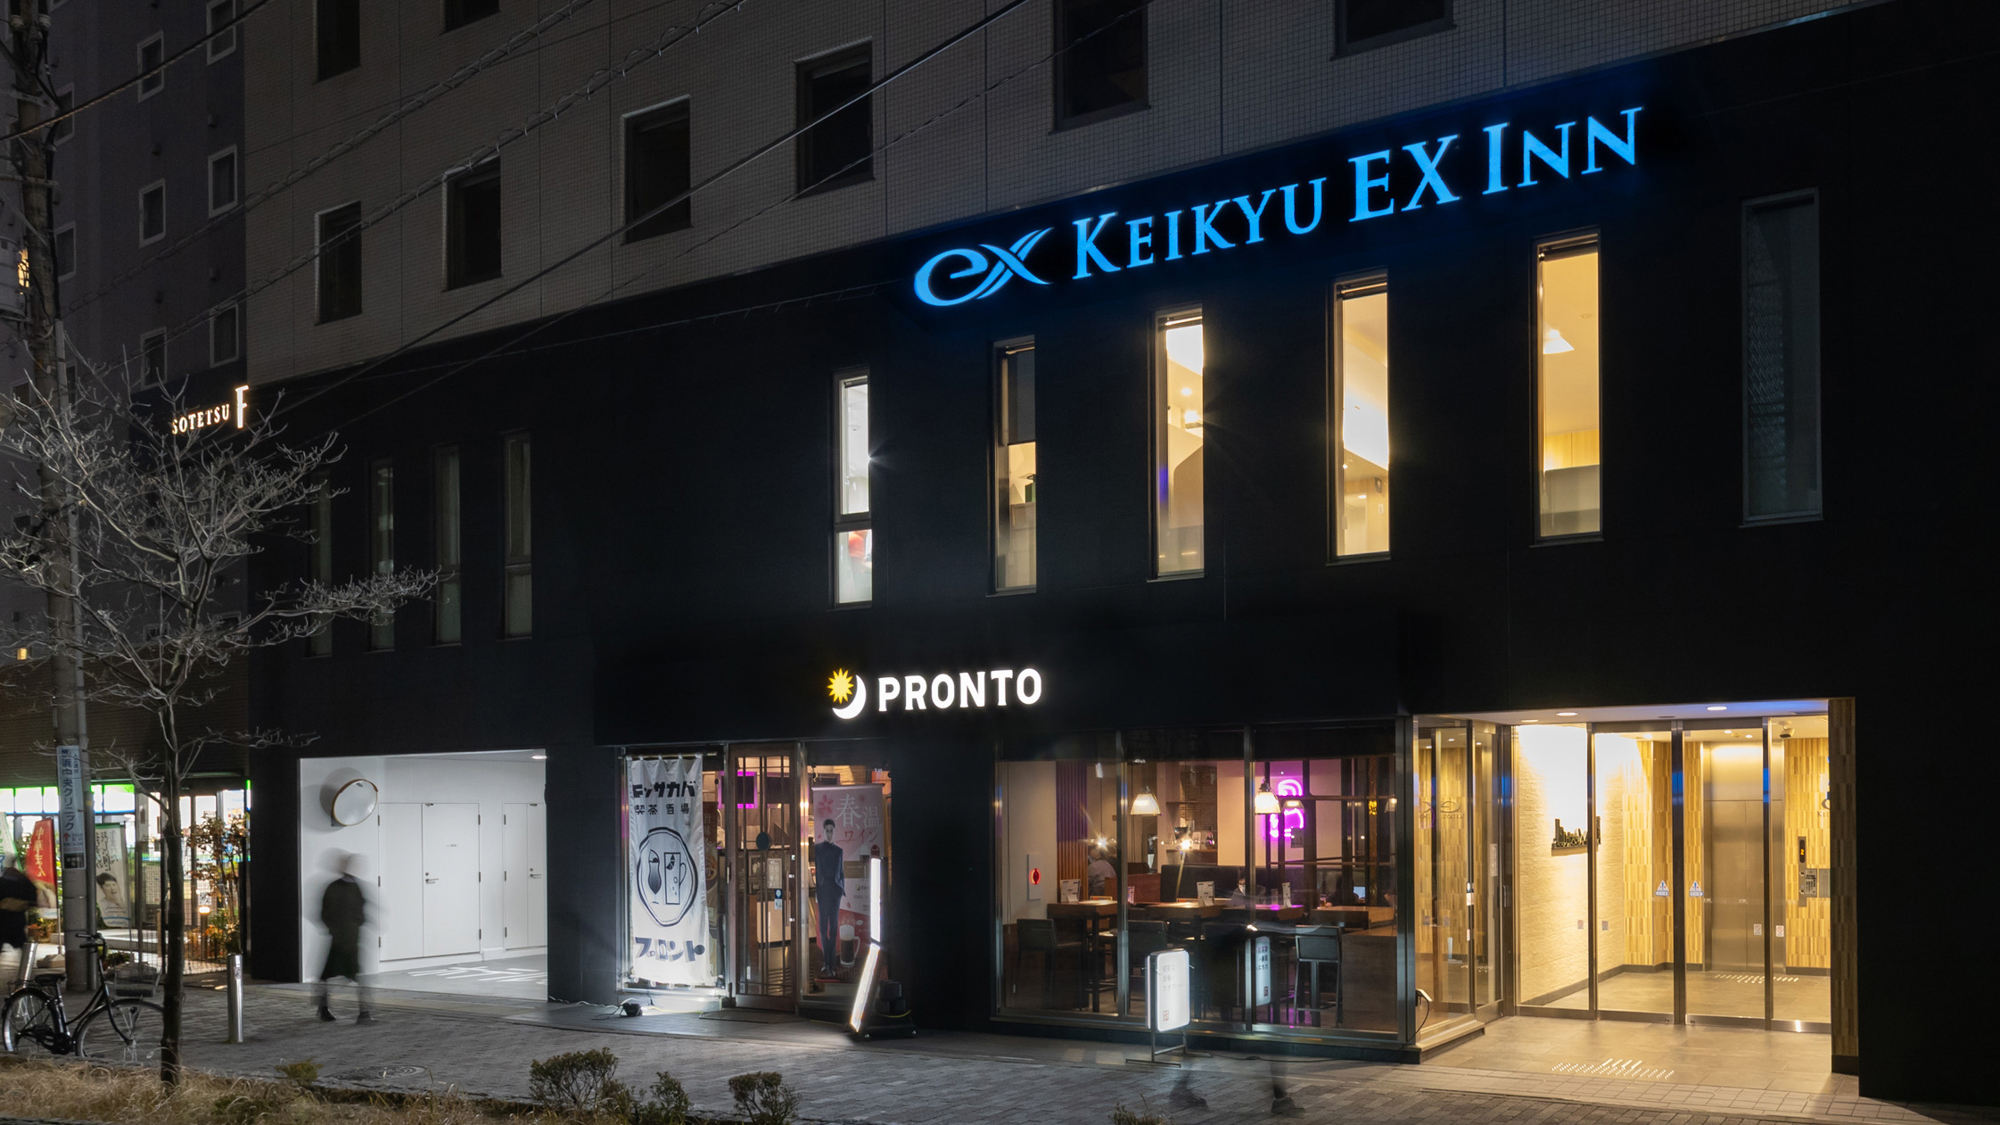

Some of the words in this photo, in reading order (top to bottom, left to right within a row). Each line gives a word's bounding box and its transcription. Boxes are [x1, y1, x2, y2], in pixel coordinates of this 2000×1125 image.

[1348, 133, 1461, 222] EX
[1482, 107, 1644, 195] INN
[171, 404, 230, 434] SOTETSU
[235, 385, 249, 429] F
[878, 668, 1042, 712] PRONTO
[634, 936, 706, 962] プロント
